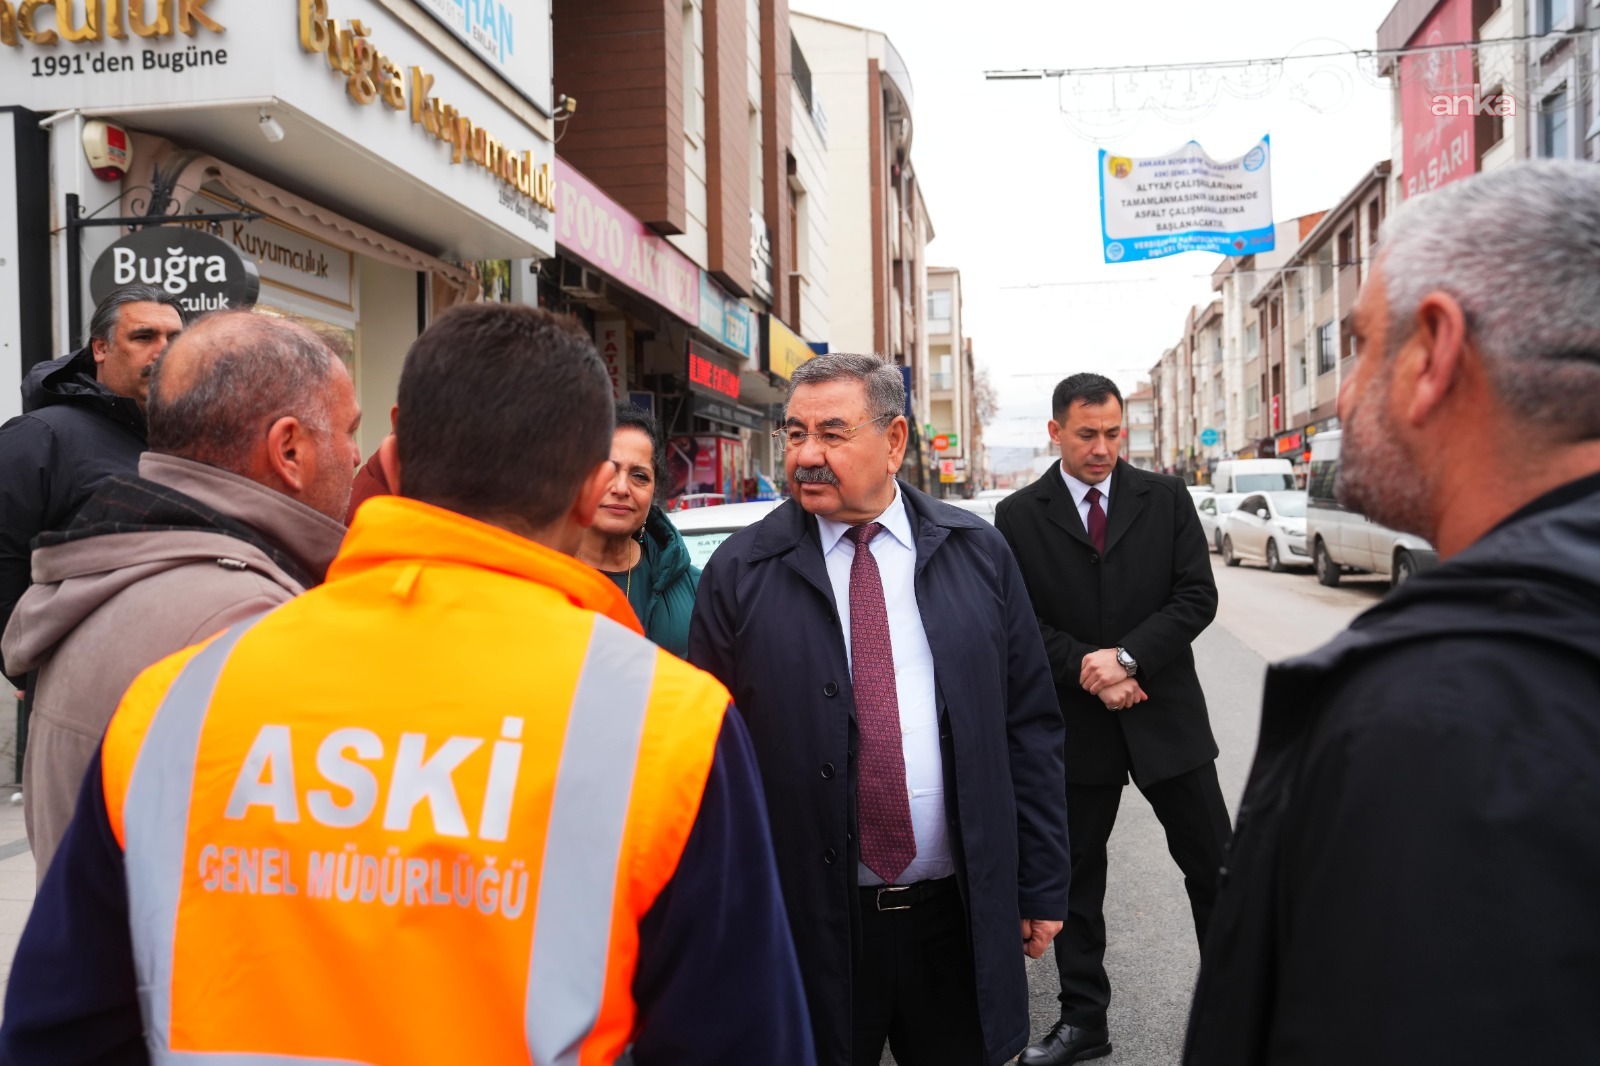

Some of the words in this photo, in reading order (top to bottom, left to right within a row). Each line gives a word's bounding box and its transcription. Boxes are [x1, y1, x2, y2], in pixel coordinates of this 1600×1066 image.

[31, 52, 134, 77] 1991'den
[142, 46, 228, 73] Bugüne
[232, 221, 329, 278] Kuyumculuk
[560, 180, 624, 269] FOTO
[113, 246, 227, 294] Buğra
[223, 715, 524, 842] ASKİ
[199, 844, 299, 894] GENEL
[307, 843, 529, 920] MÜDÜRLÜĞÜ
